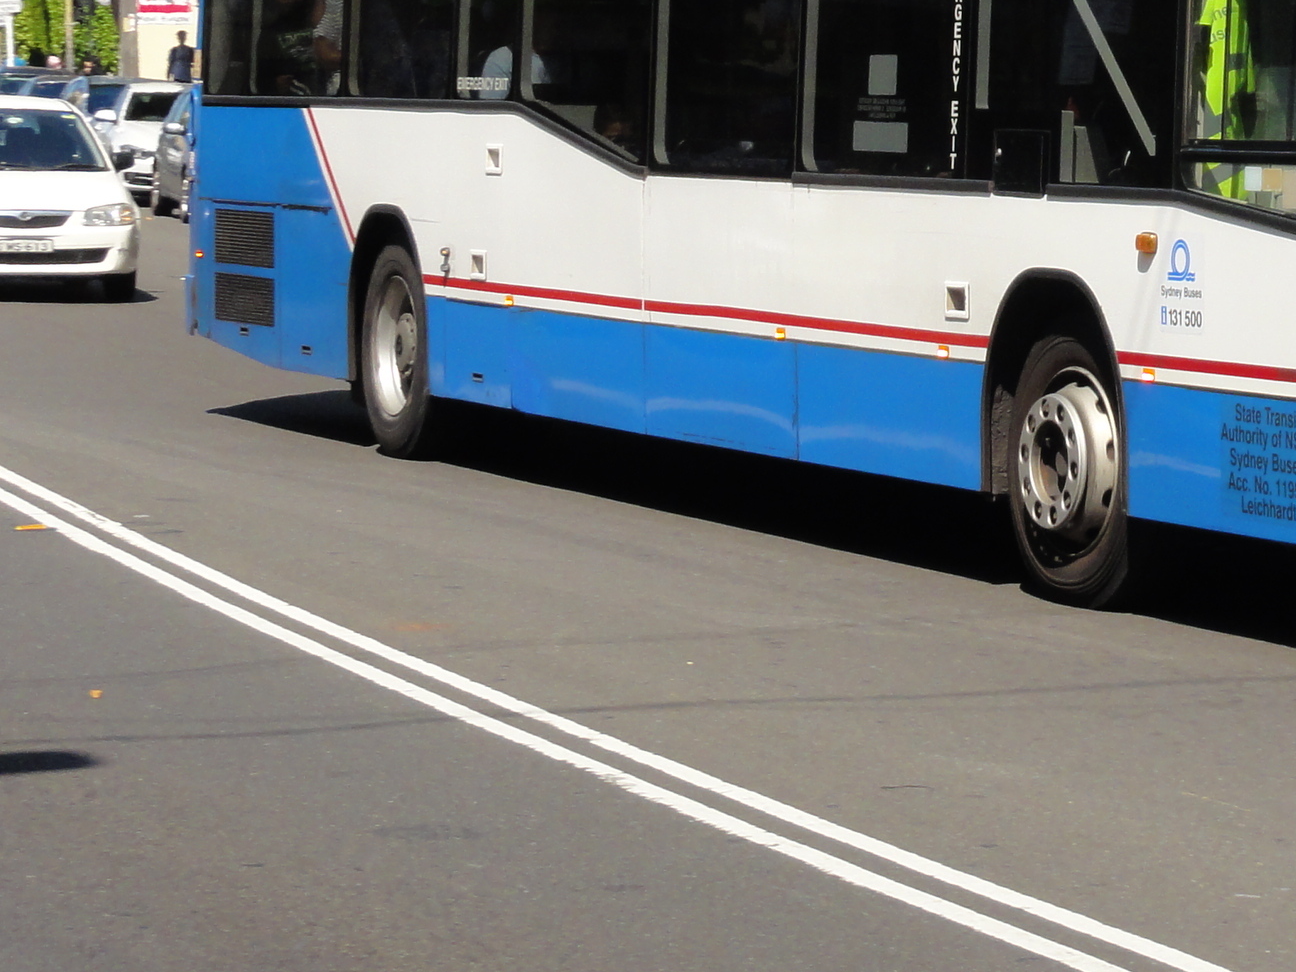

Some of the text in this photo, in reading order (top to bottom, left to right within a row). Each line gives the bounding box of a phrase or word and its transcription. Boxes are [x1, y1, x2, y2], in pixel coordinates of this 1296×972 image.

[457, 77, 509, 90] EMERGENCY EXIT
[950, 100, 959, 170] EXIT
[1161, 285, 1202, 299] Sydney Buses
[1168, 309, 1203, 328] 131 500
[1235, 403, 1261, 424] State
[1221, 423, 1268, 451] Authority
[1271, 430, 1282, 448] of
[1230, 447, 1268, 474] Sydney
[1228, 471, 1251, 492] Acc.
[1254, 475, 1272, 495] No.
[1241, 495, 1296, 521] Leichhardt
